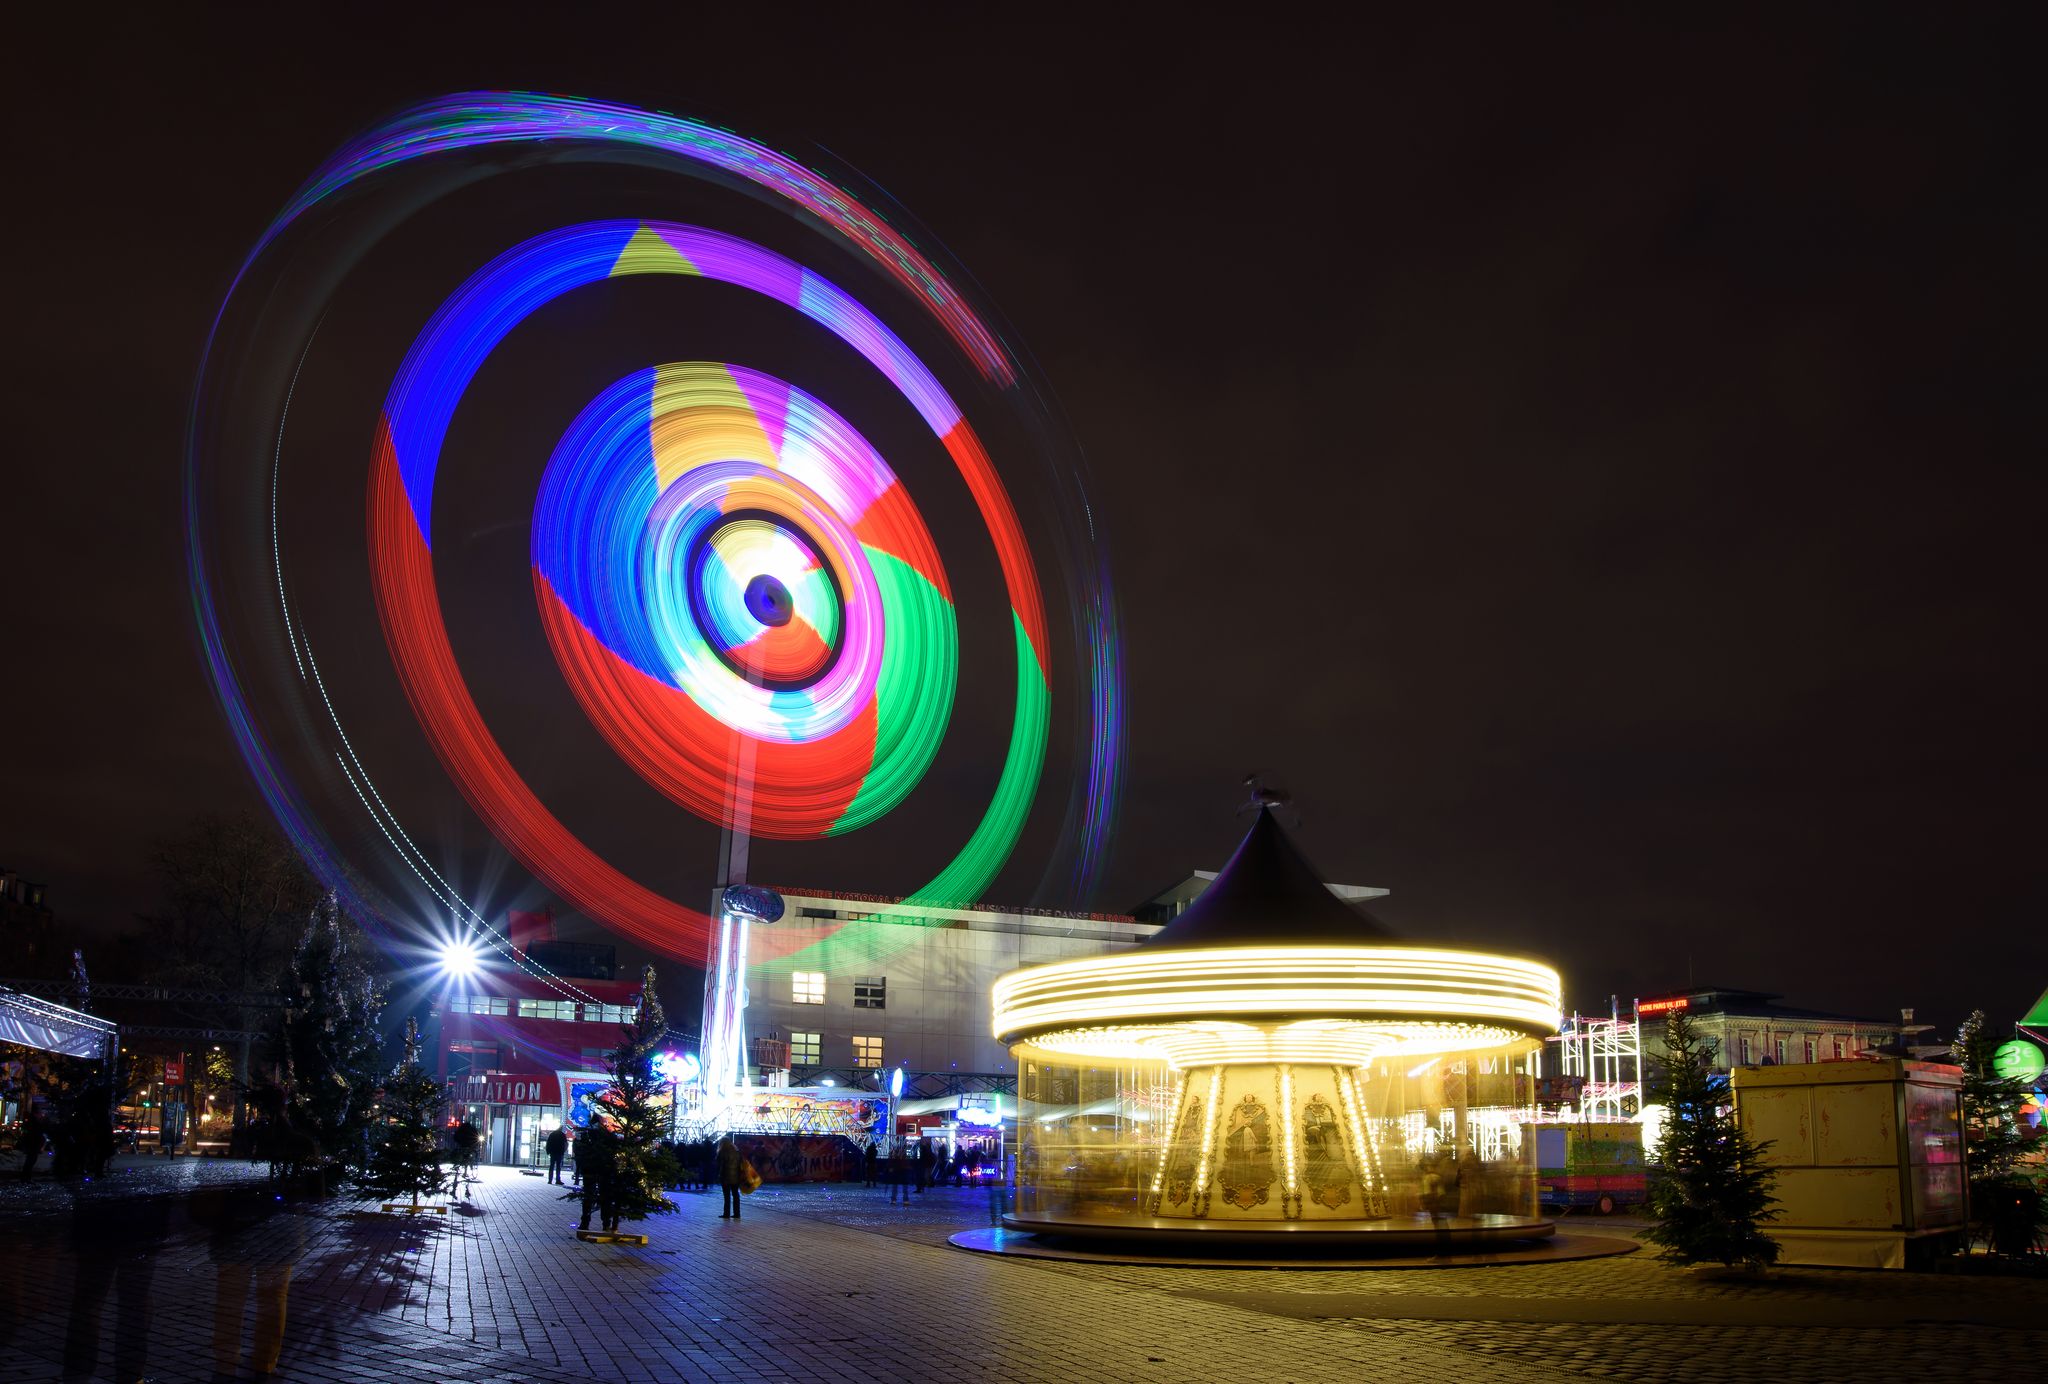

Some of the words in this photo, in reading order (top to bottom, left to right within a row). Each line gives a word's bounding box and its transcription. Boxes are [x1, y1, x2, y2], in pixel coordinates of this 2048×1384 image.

[835, 891, 891, 903] NATIONAL
[973, 903, 1021, 914] MUSIQUE
[1024, 907, 1036, 916] ET
[1038, 908, 1052, 917] DE
[1054, 910, 1089, 920] DANSE
